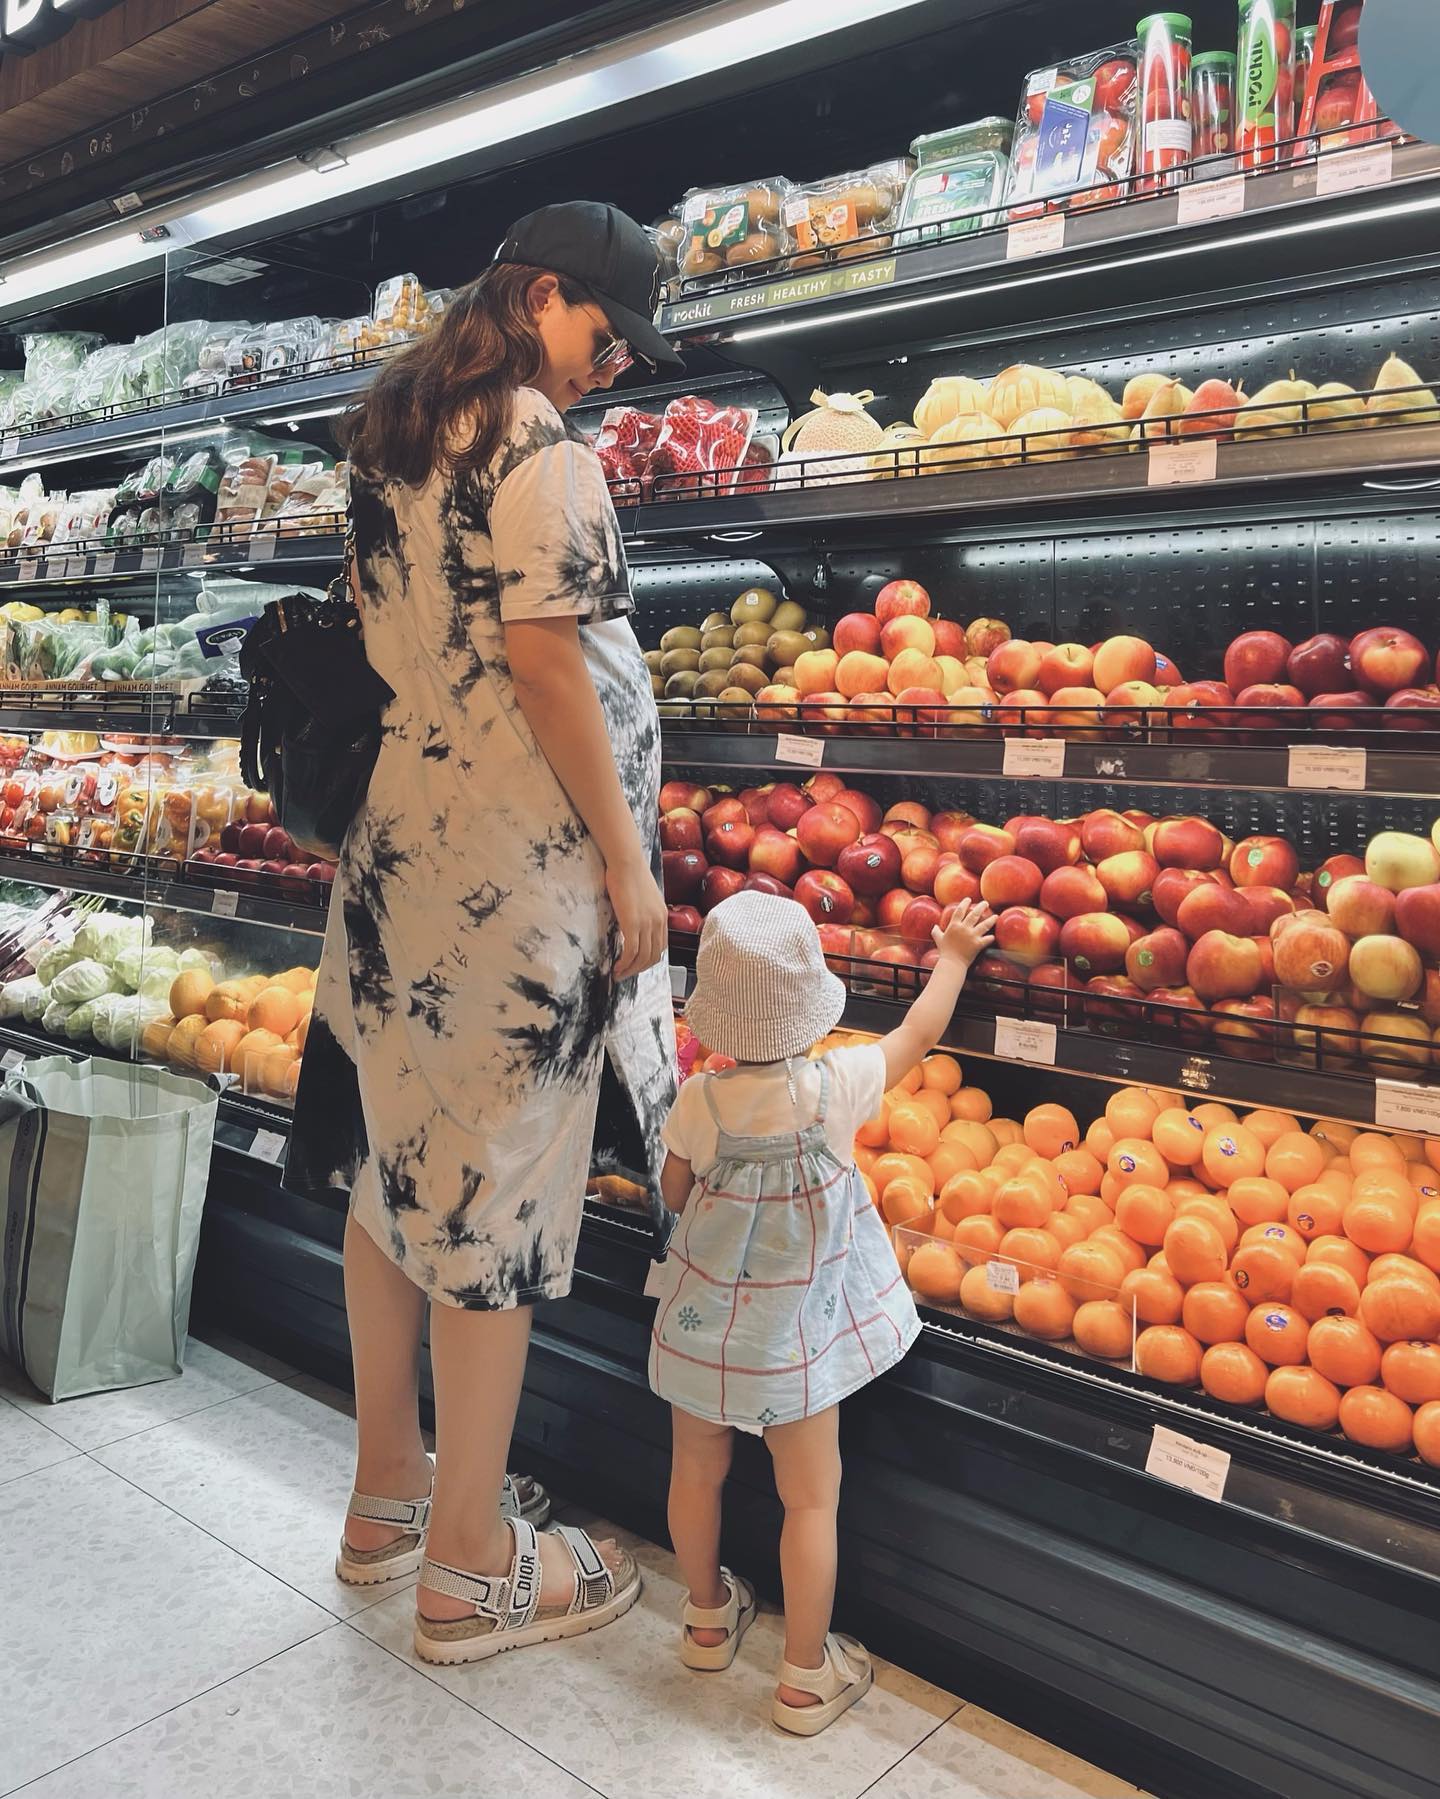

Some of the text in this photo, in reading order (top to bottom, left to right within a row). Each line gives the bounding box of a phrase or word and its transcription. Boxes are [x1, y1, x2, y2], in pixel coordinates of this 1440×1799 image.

[1248, 39, 1263, 107] rockit
[730, 265, 893, 310] FRESH HEALTHY TASTY
[673, 303, 712, 323] rockit
[517, 1554, 535, 1591] DIOR
